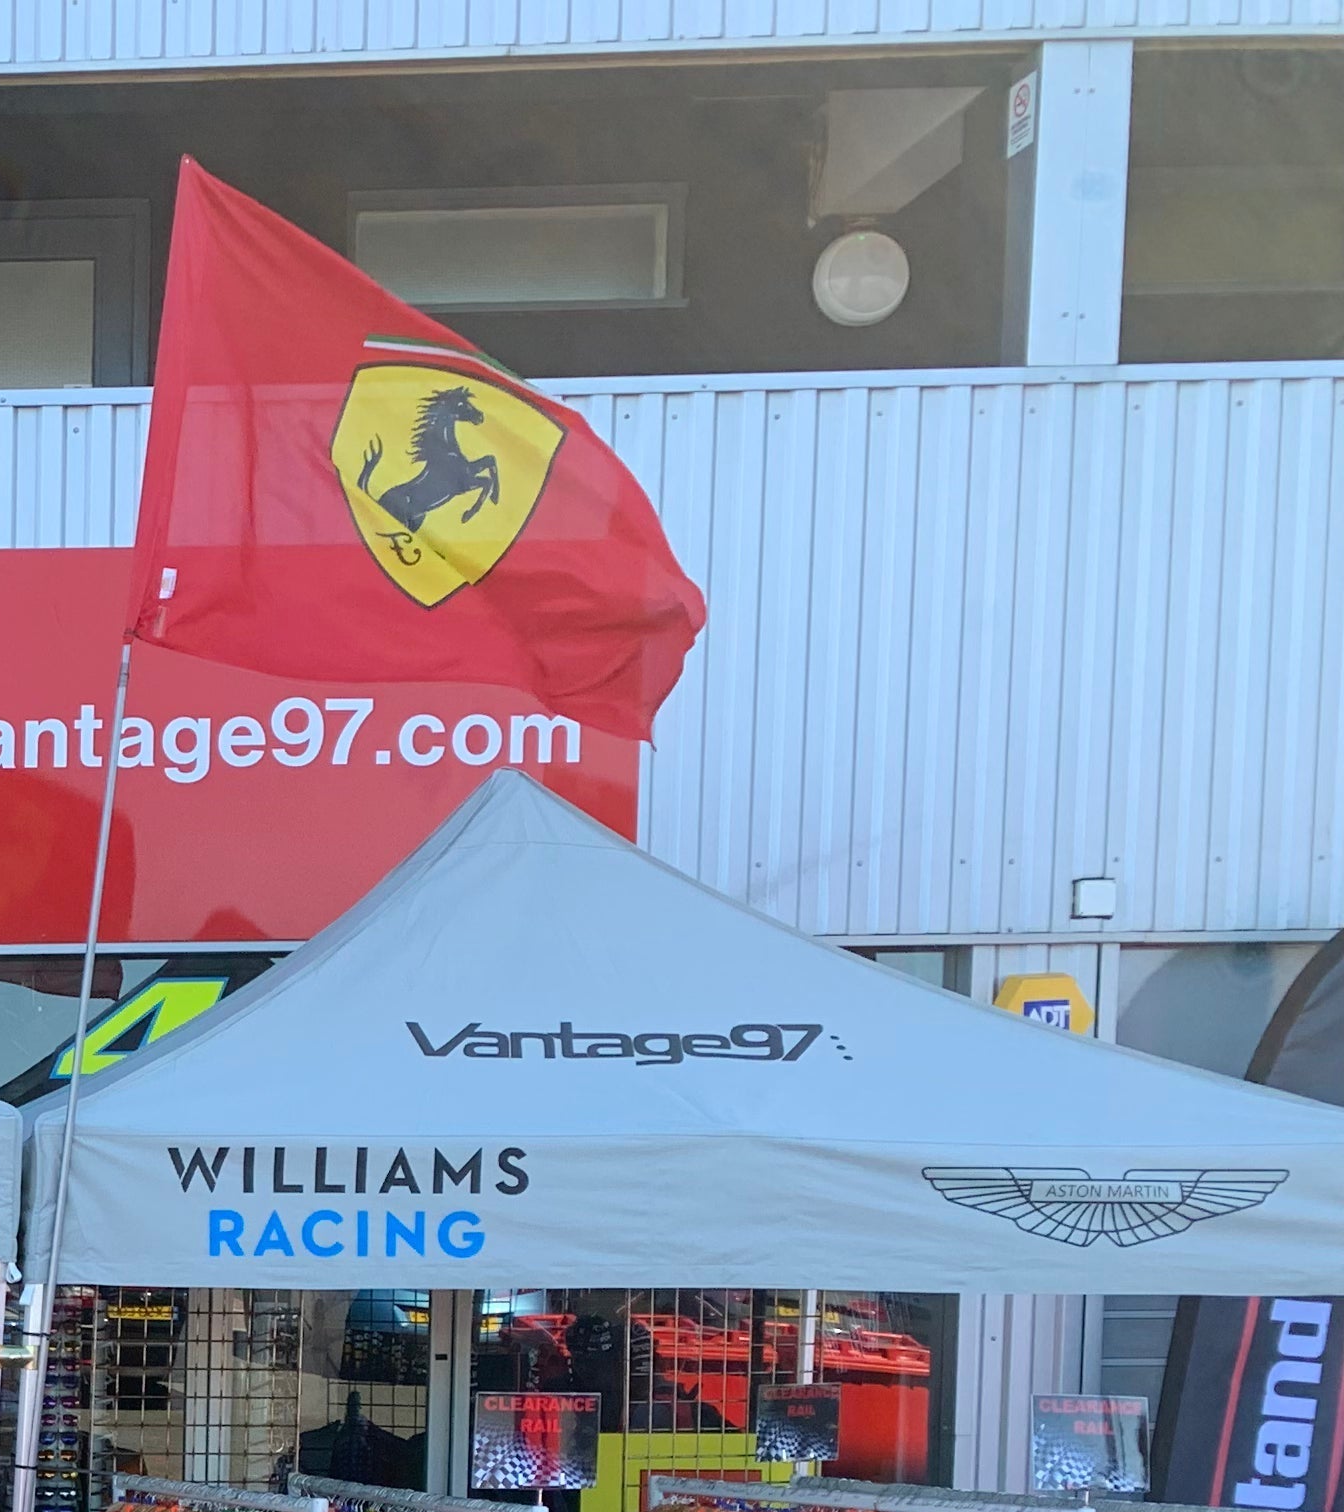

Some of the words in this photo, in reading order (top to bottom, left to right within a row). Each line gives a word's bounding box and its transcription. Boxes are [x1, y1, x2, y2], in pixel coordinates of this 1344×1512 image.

[405, 1021, 824, 1066] Vantage97
[167, 1146, 530, 1196] WILLIAMS
[1045, 1183, 1102, 1199] ASTON
[1107, 1184, 1170, 1199] MARTIN
[208, 1208, 487, 1259] RACING
[484, 1395, 596, 1412] CLEARANCE
[1039, 1398, 1142, 1415] CLEARANCE
[521, 1418, 562, 1433] RAIL
[1074, 1420, 1114, 1435] RAIL
